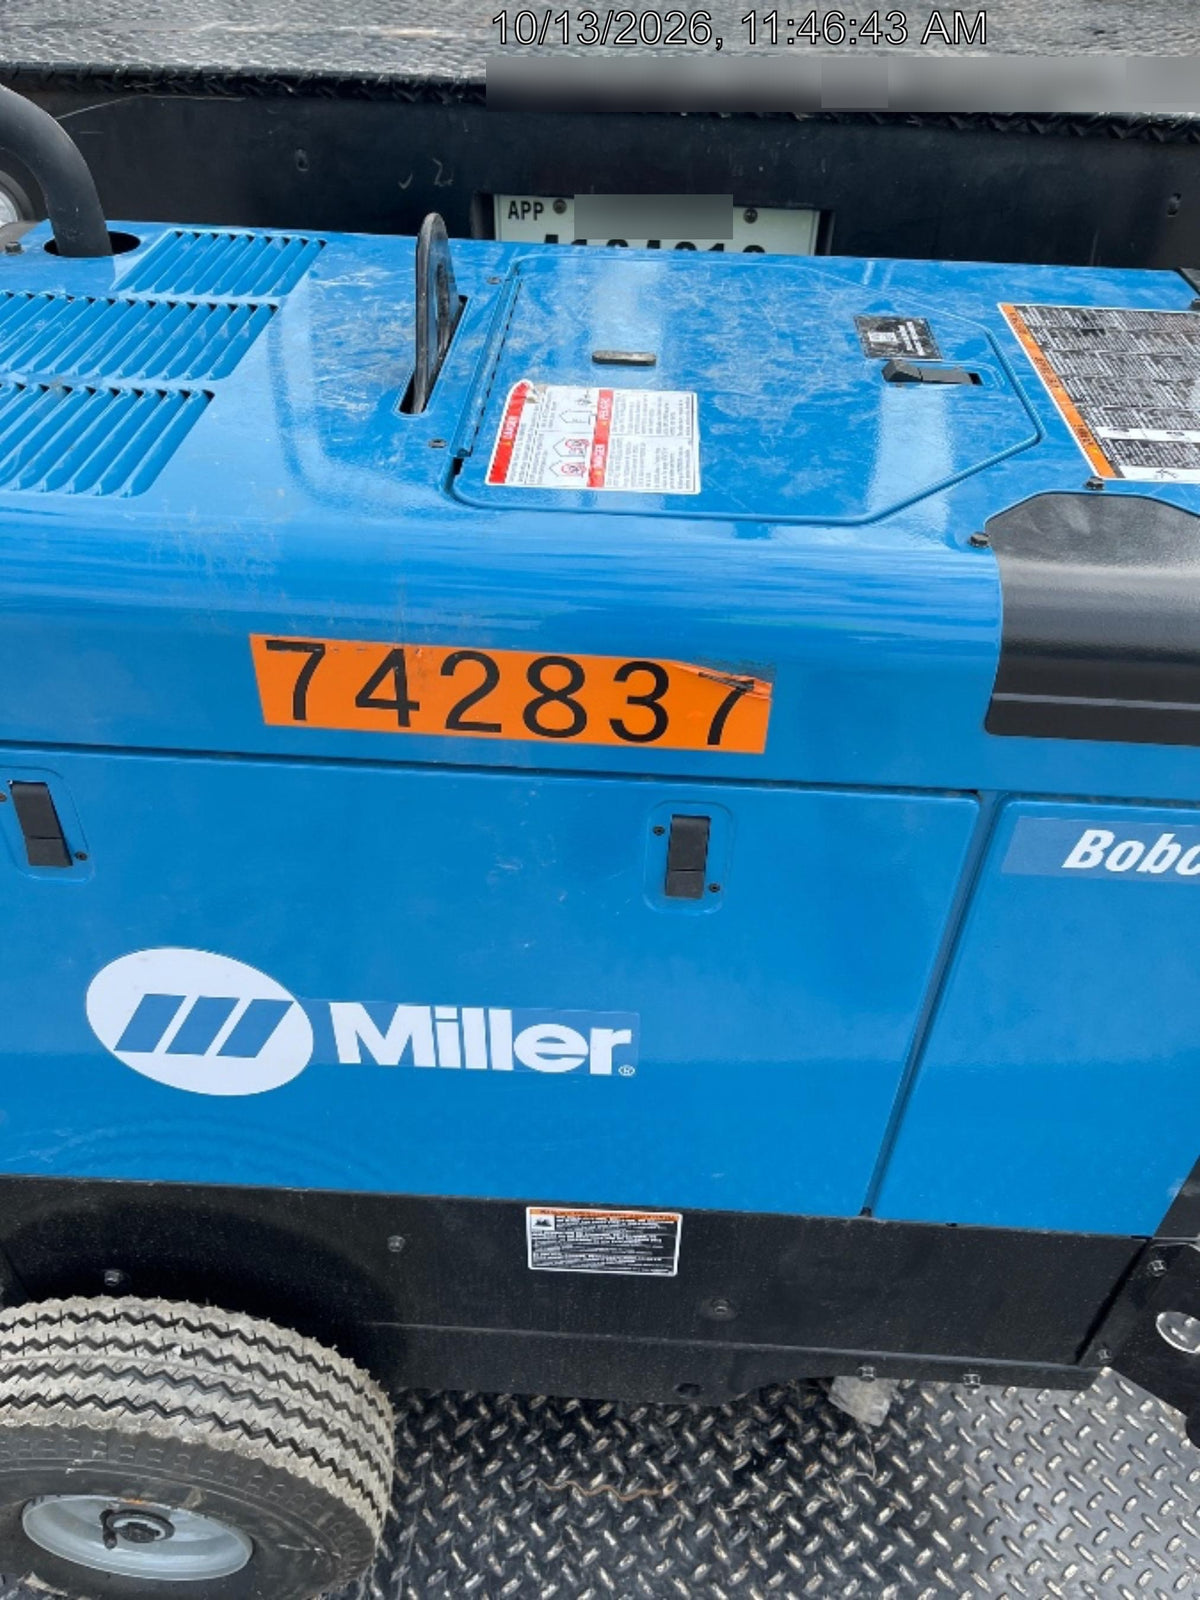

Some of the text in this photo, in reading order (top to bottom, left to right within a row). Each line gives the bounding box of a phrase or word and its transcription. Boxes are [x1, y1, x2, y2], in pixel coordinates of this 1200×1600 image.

[508, 200, 544, 221] APP
[266, 639, 755, 746] 742837
[329, 1002, 633, 1075] Miller
